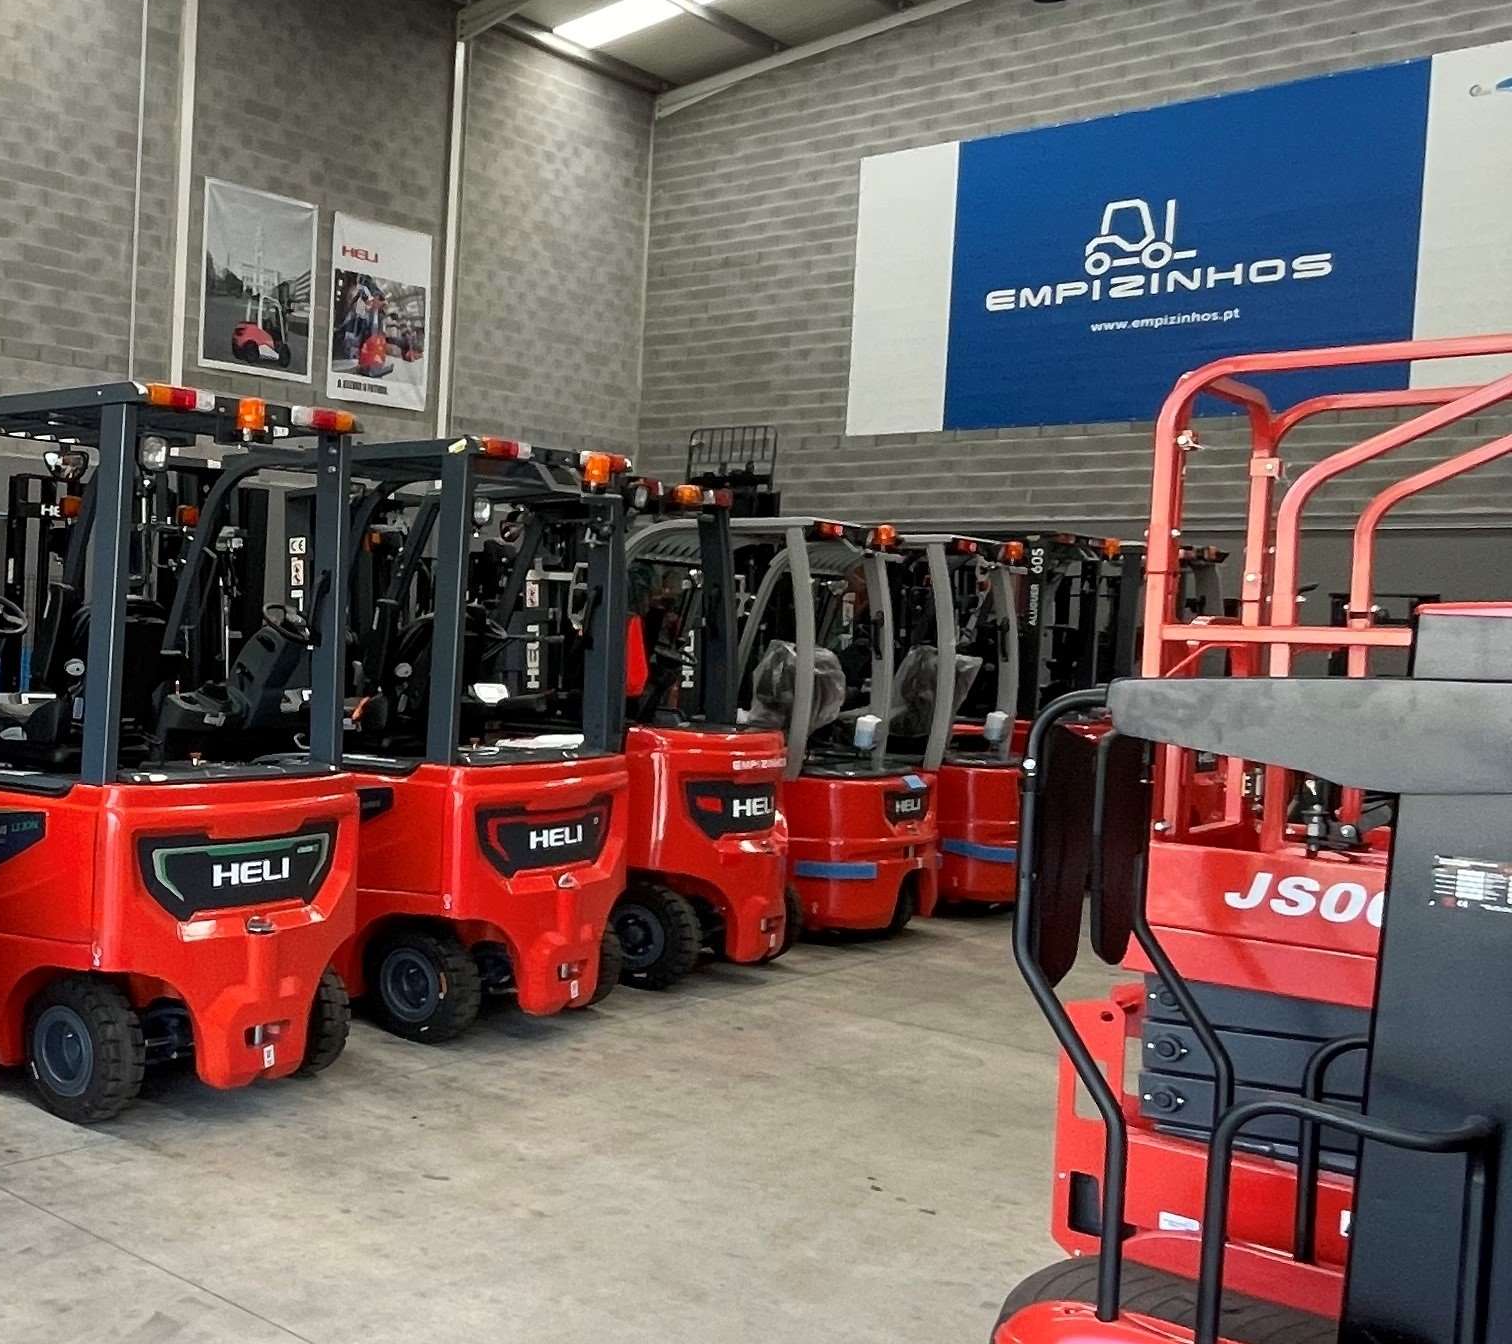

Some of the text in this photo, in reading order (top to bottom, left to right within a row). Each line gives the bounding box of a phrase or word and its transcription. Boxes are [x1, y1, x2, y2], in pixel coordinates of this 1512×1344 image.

[341, 245, 379, 263] HELI
[986, 253, 1332, 311] EMPIZINHOS
[1090, 307, 1240, 332] www.empizinhos.pt
[1030, 547, 1045, 574] 605
[527, 624, 540, 689] HELI
[530, 824, 583, 849] HELI
[212, 857, 290, 888] HELI
